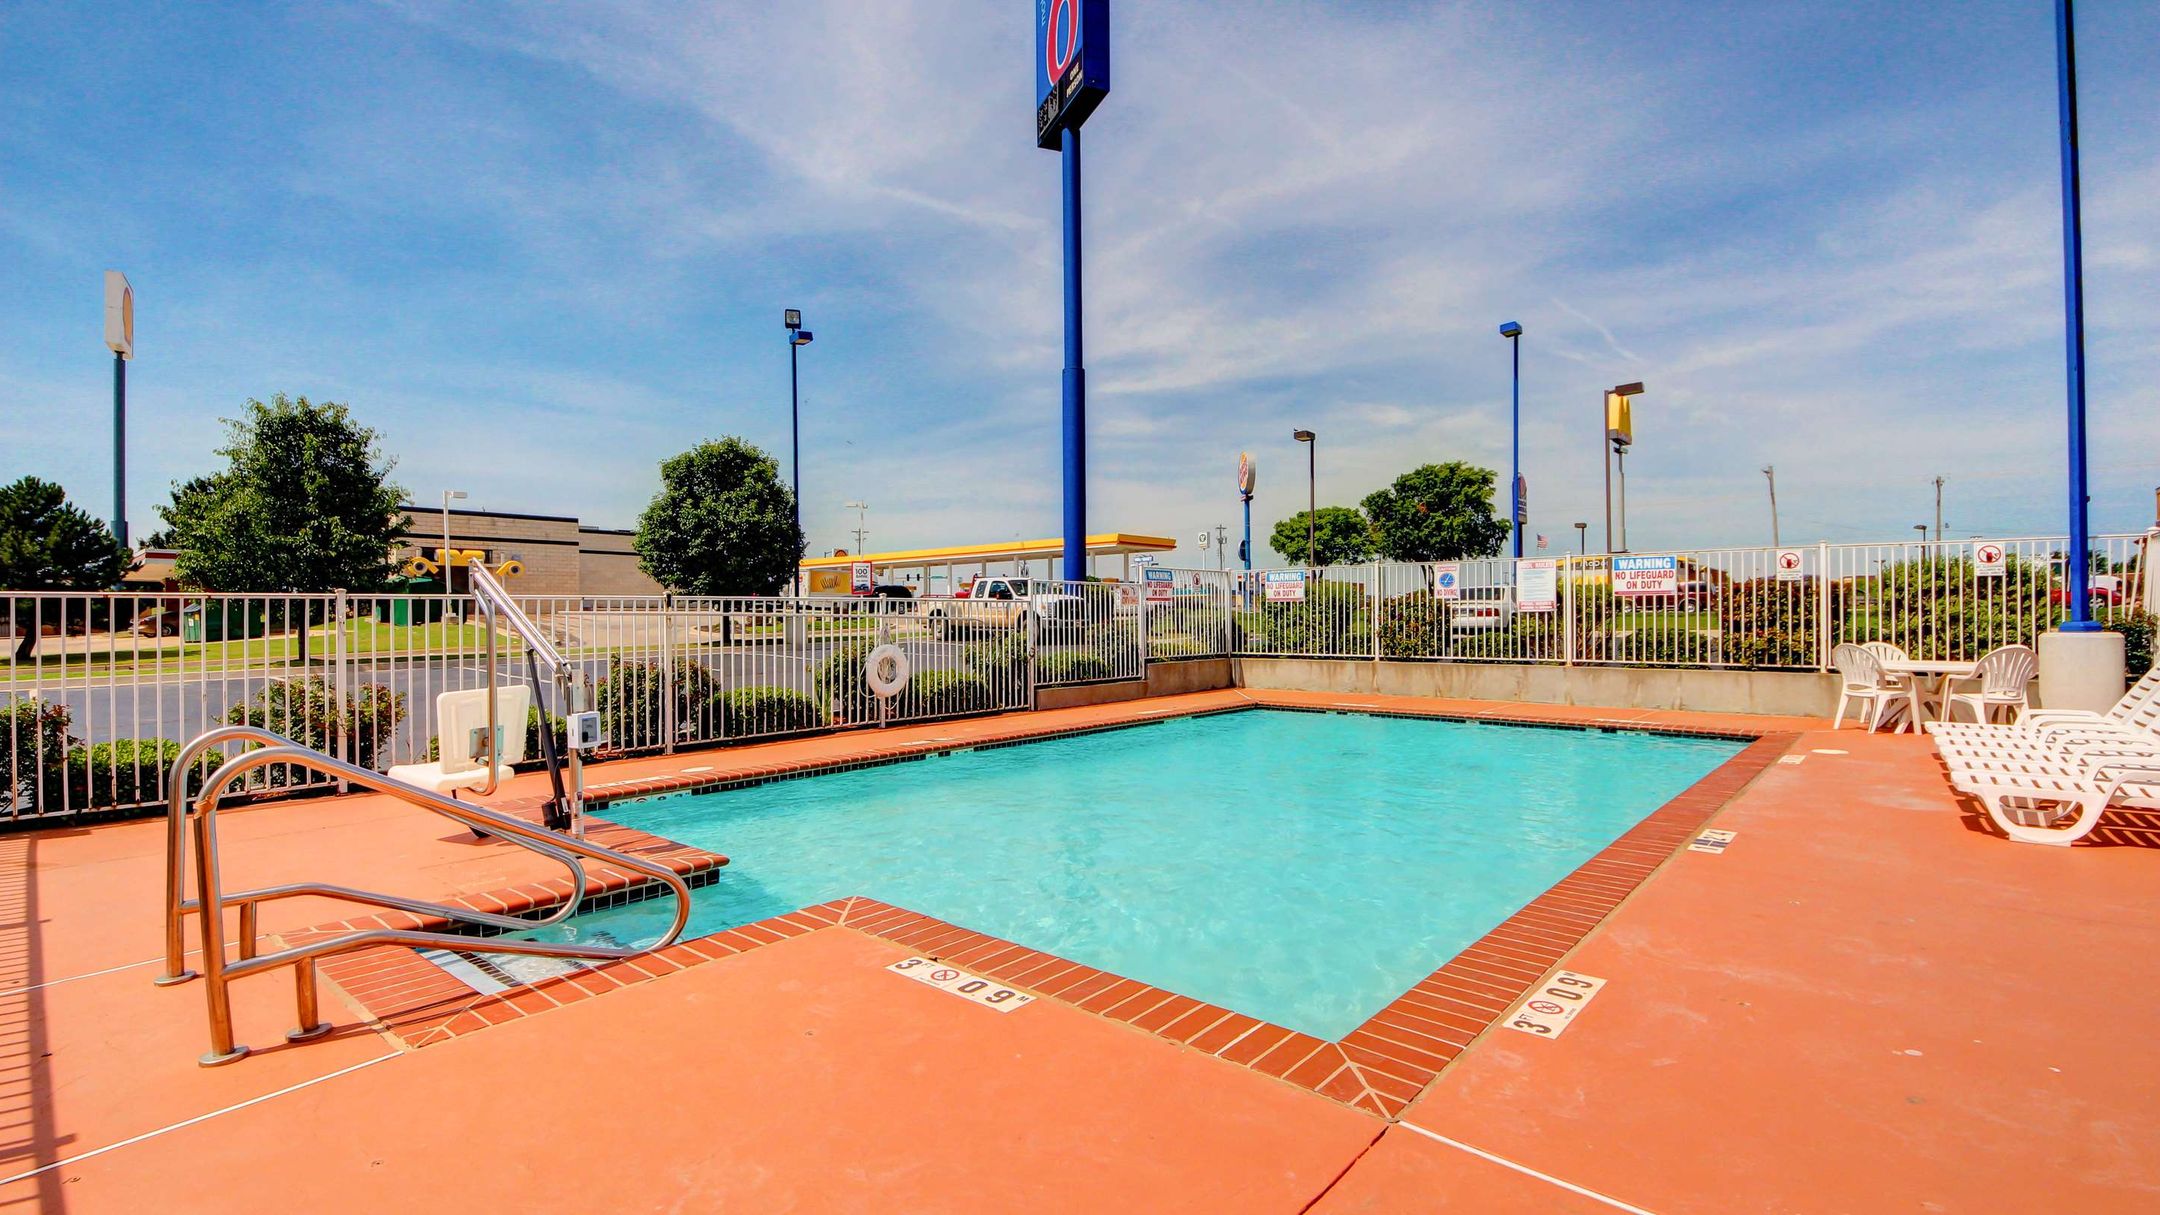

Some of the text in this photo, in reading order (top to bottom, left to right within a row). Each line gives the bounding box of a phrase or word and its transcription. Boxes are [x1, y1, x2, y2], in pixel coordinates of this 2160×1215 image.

[1618, 558, 1671, 570] WARNING
[1147, 570, 1171, 580] WARNING
[1269, 572, 1301, 582] WARNING
[1615, 570, 1674, 580] NO LIFEGUARD
[1275, 581, 1303, 589] LIFEGUARD
[1626, 580, 1663, 589] ON DUTY
[895, 959, 923, 970] 3
[957, 980, 1016, 1004] 0.9
[1513, 1020, 1552, 1034] 3
[1546, 977, 1593, 1001] 0.9
